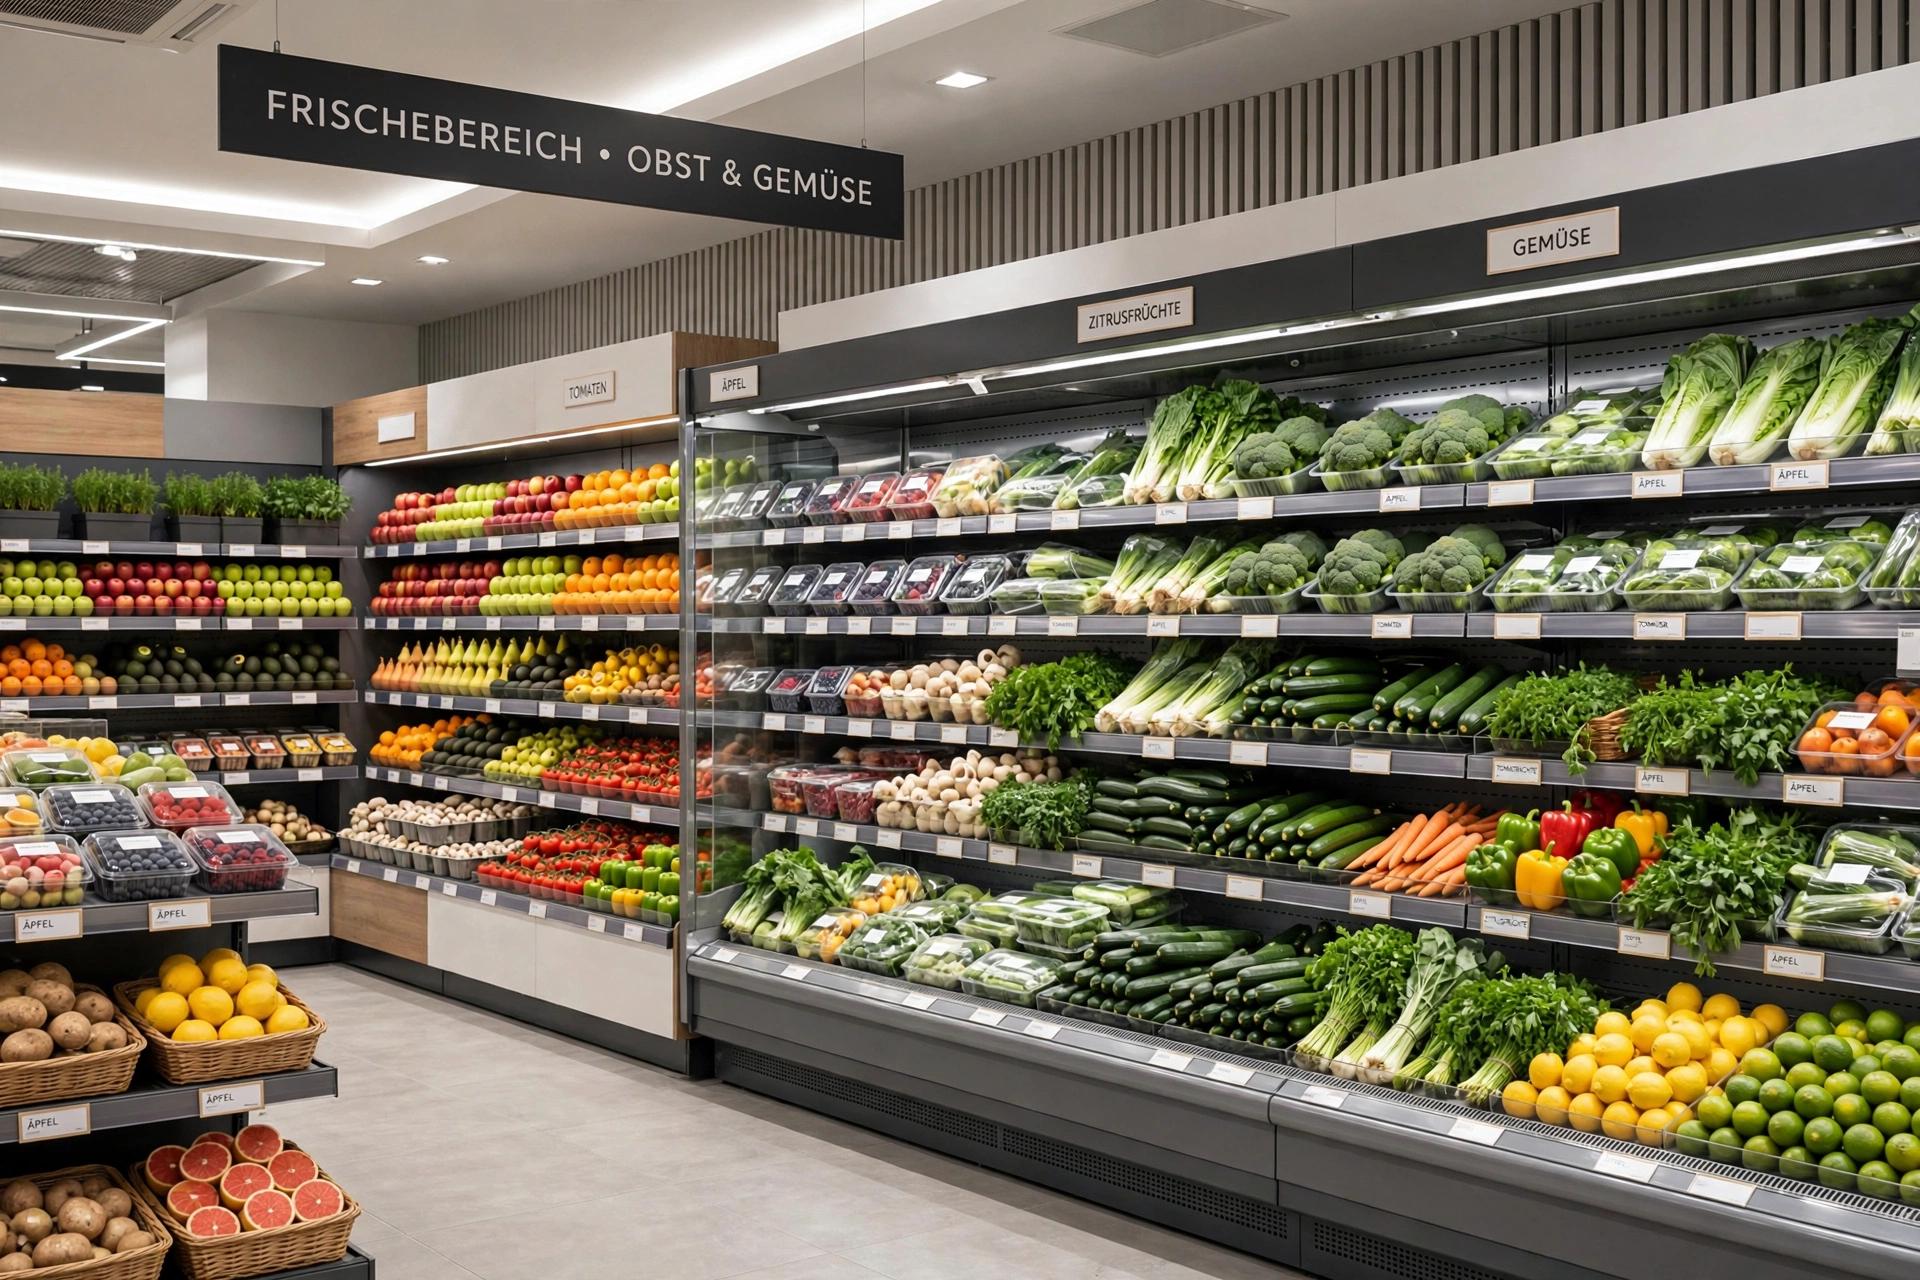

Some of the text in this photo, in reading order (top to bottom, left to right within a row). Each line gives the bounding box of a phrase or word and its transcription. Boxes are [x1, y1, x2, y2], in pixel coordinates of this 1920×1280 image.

[266, 88, 583, 165] FRISCHEBEREICH
[627, 145, 712, 182] OBST
[722, 159, 742, 187] &
[753, 163, 873, 206] GEMÜSE
[1513, 227, 1591, 256] GEMÜSE
[1089, 301, 1181, 330] ZITRUSFRÜCHTE
[569, 381, 607, 400] TOMATEN
[722, 377, 747, 392] ÄPFEL
[1778, 469, 1809, 480] ÄPFEL
[1638, 477, 1666, 488] ÄPFEL
[1642, 772, 1665, 783] ÄPFEL
[1790, 782, 1817, 793] ÄPFEL
[157, 909, 186, 920] ÄPFEL
[23, 918, 54, 930] ÄPFEL
[1771, 954, 1799, 966] ÄPFEL
[206, 1093, 235, 1104] ÄPFEL
[27, 1117, 59, 1130] ÄPFEL
